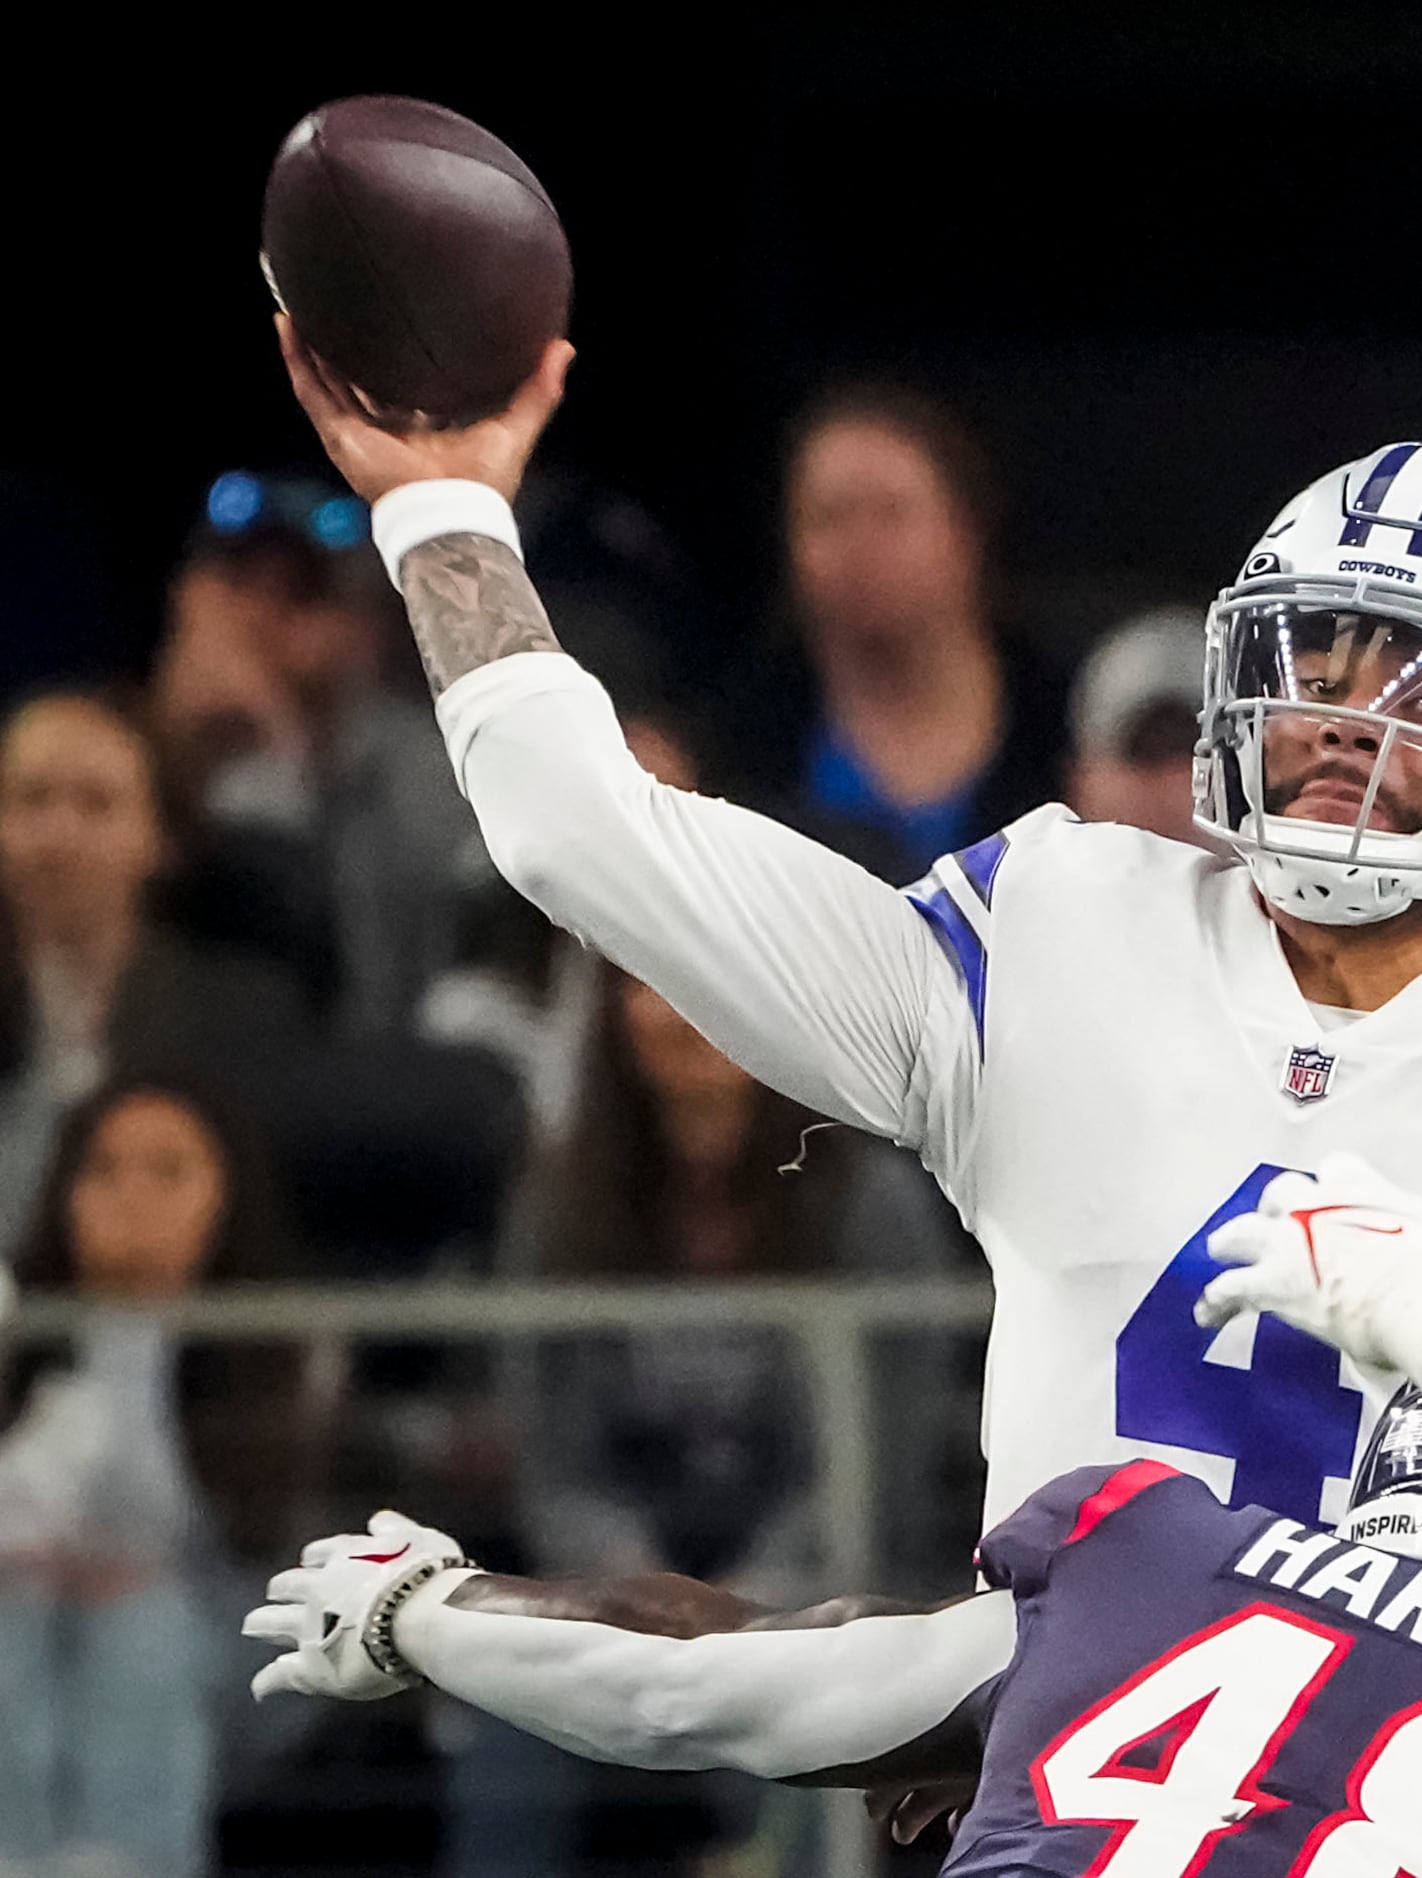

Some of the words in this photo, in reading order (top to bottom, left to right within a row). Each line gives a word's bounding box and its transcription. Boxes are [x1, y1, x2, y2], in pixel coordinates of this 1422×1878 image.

[1338, 560, 1417, 583] COWBOYS
[1289, 1068, 1321, 1093] NFL
[1116, 1163, 1364, 1531] 4
